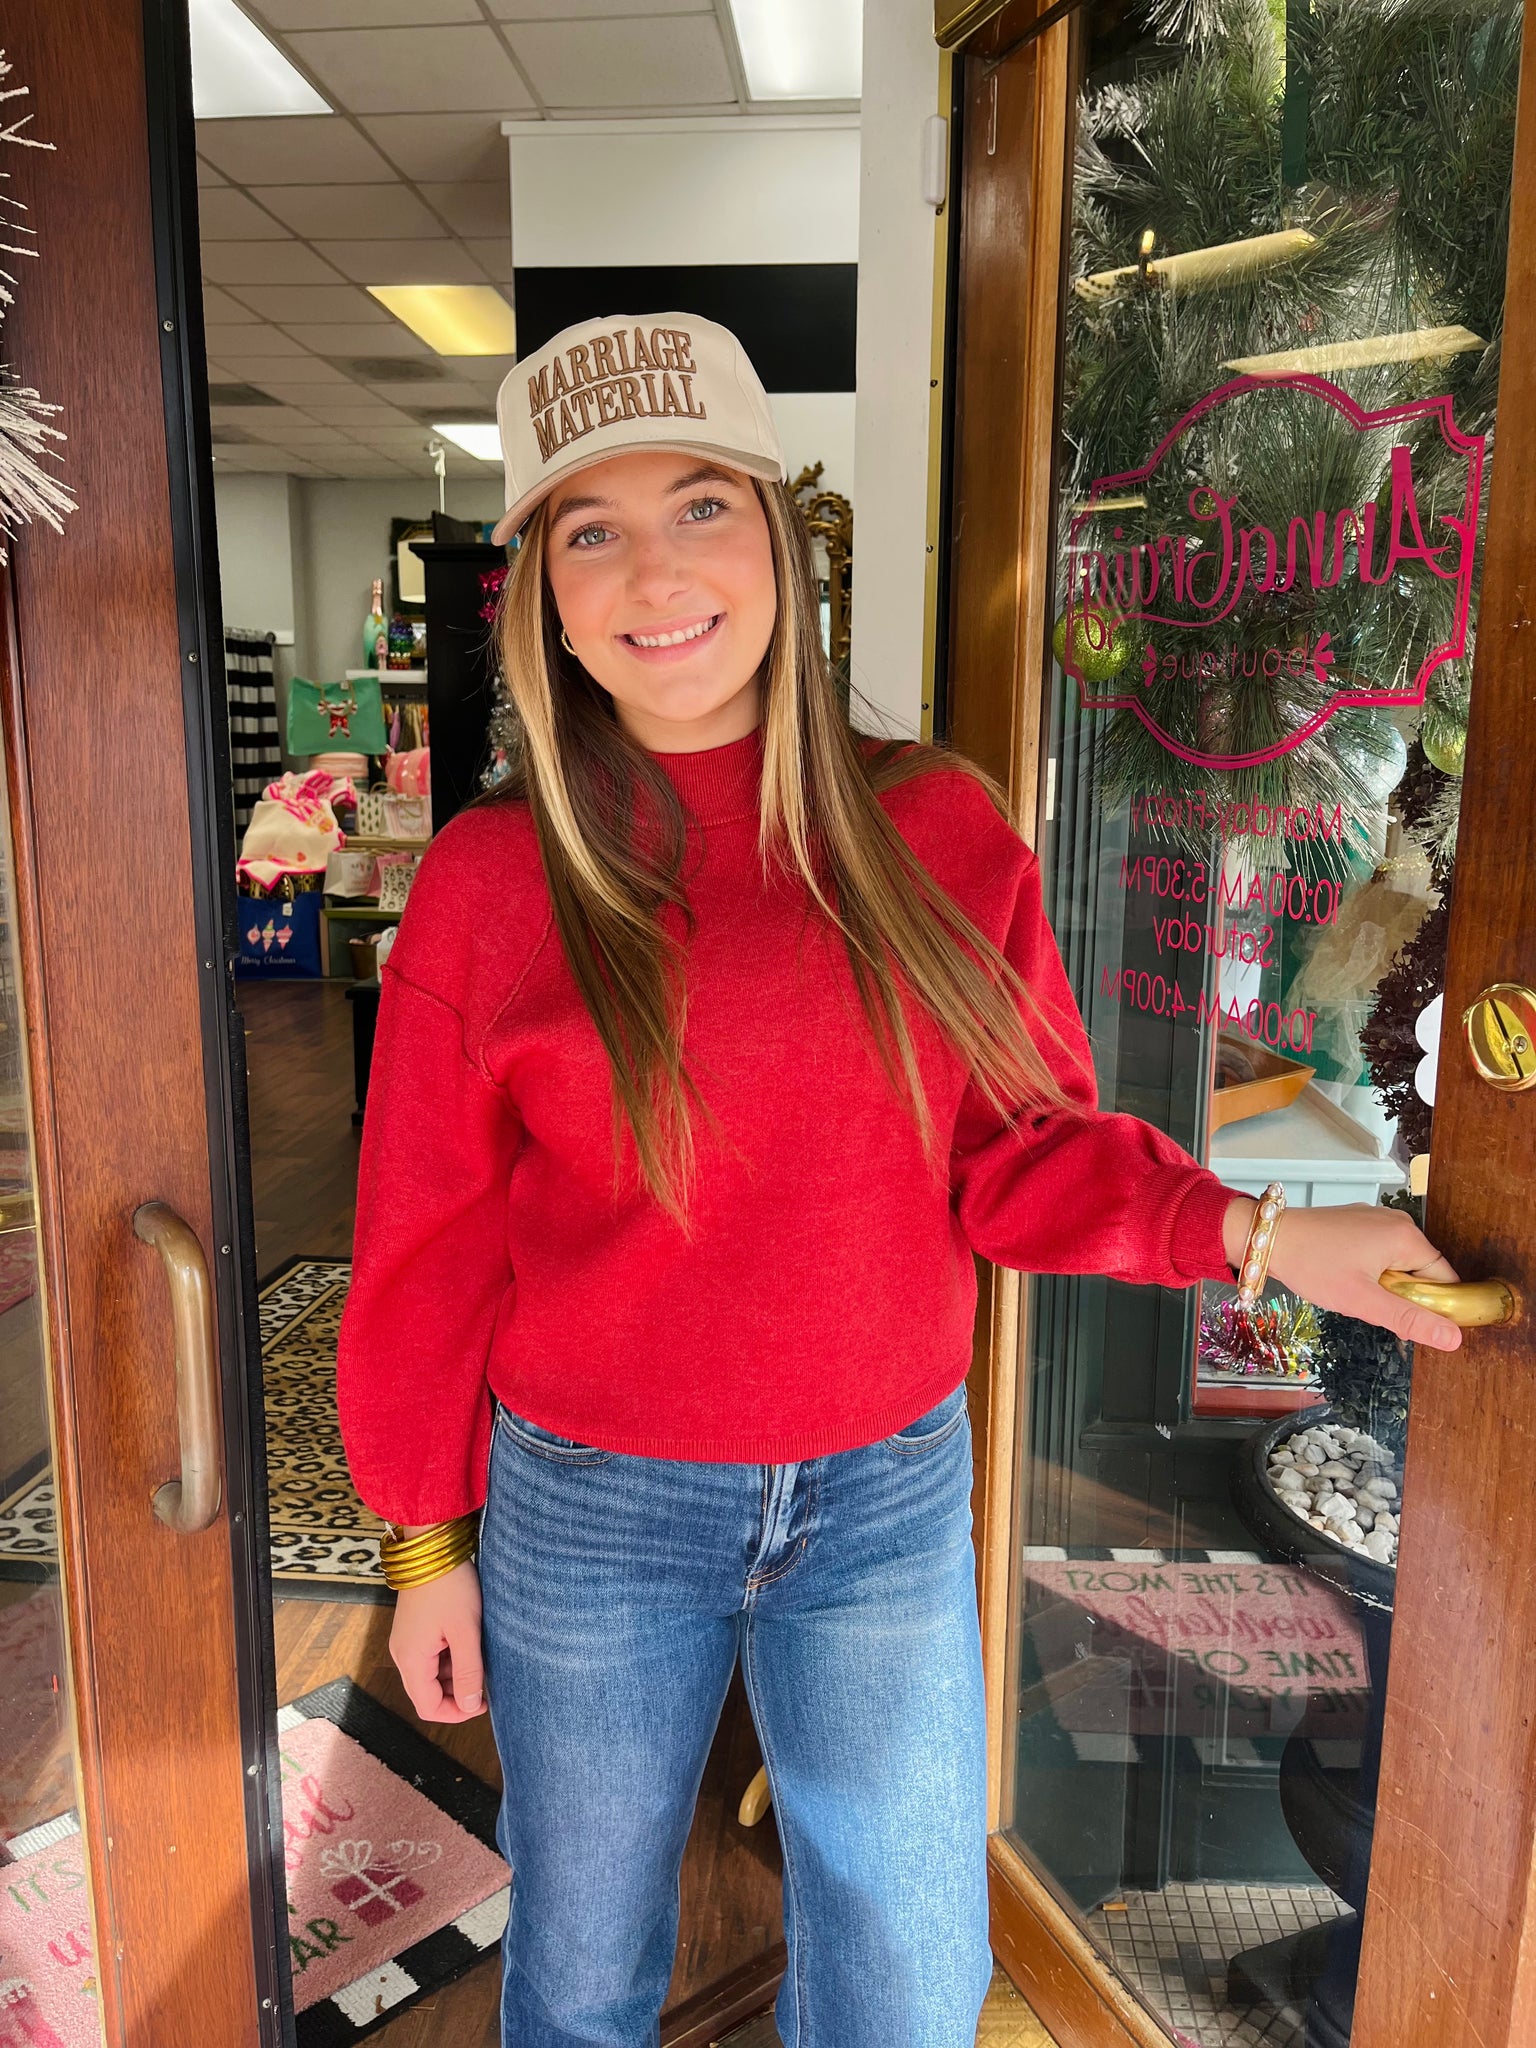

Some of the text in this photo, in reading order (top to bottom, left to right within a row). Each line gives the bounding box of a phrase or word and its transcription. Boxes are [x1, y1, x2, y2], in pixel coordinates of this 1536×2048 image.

[527, 327, 696, 418] MARRIAGE
[532, 373, 706, 464] MATERIAL
[7, 1858, 86, 1914] IT'S
